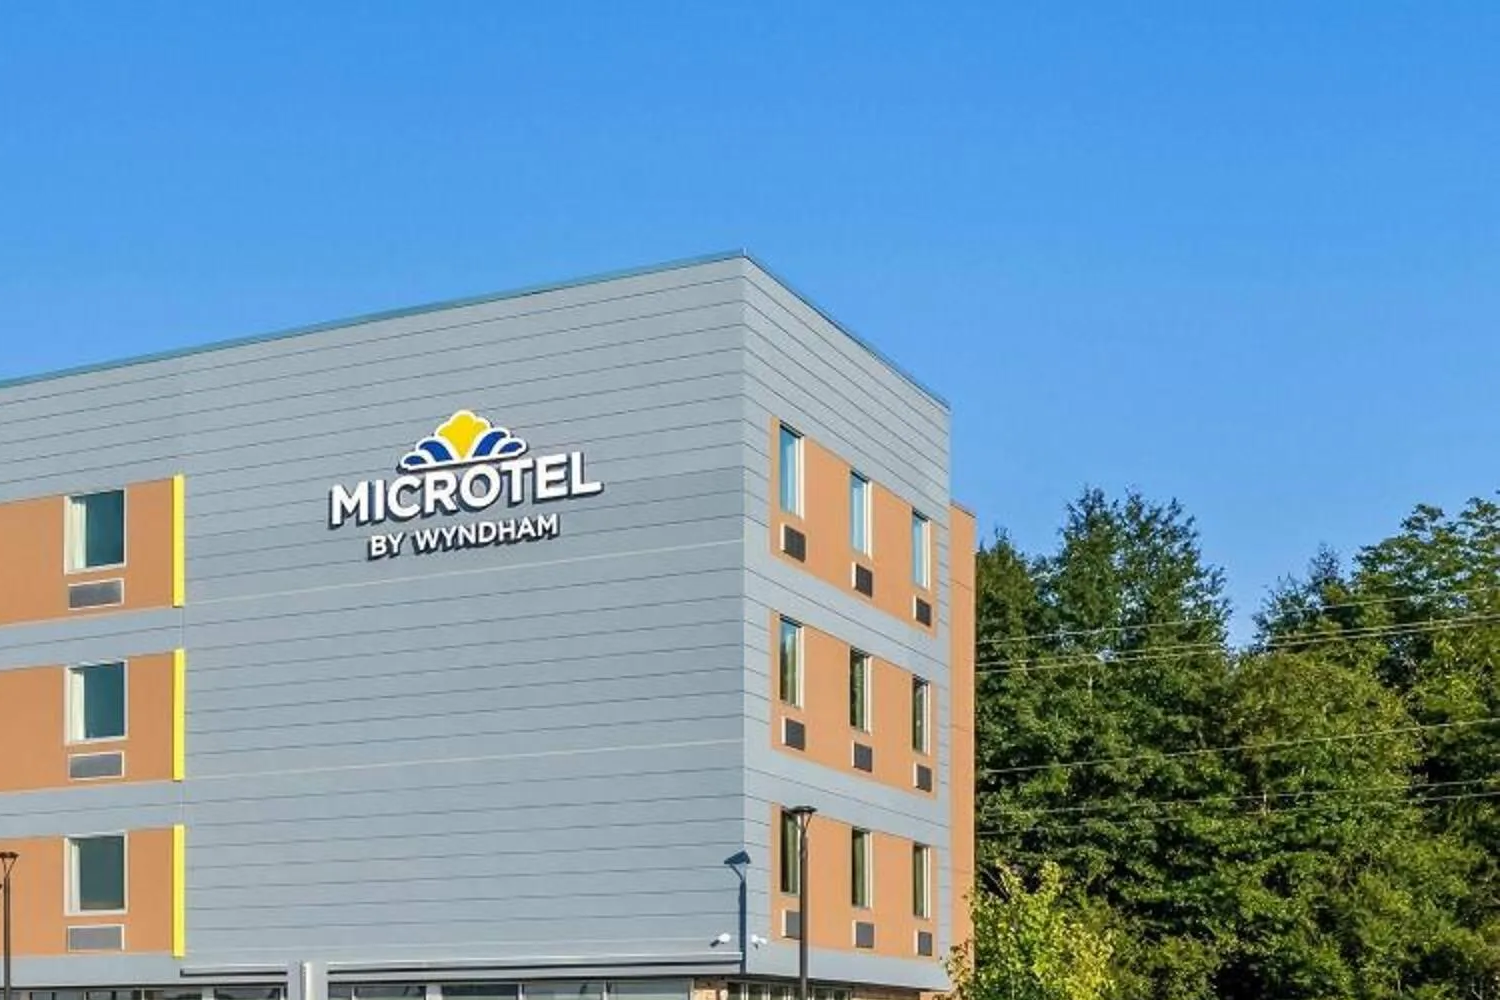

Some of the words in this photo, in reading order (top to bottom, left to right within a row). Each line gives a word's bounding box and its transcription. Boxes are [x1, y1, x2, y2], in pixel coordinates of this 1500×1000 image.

[329, 451, 602, 526] MICROTEL
[370, 532, 403, 558] BY
[415, 512, 558, 552] WYNDHAM
